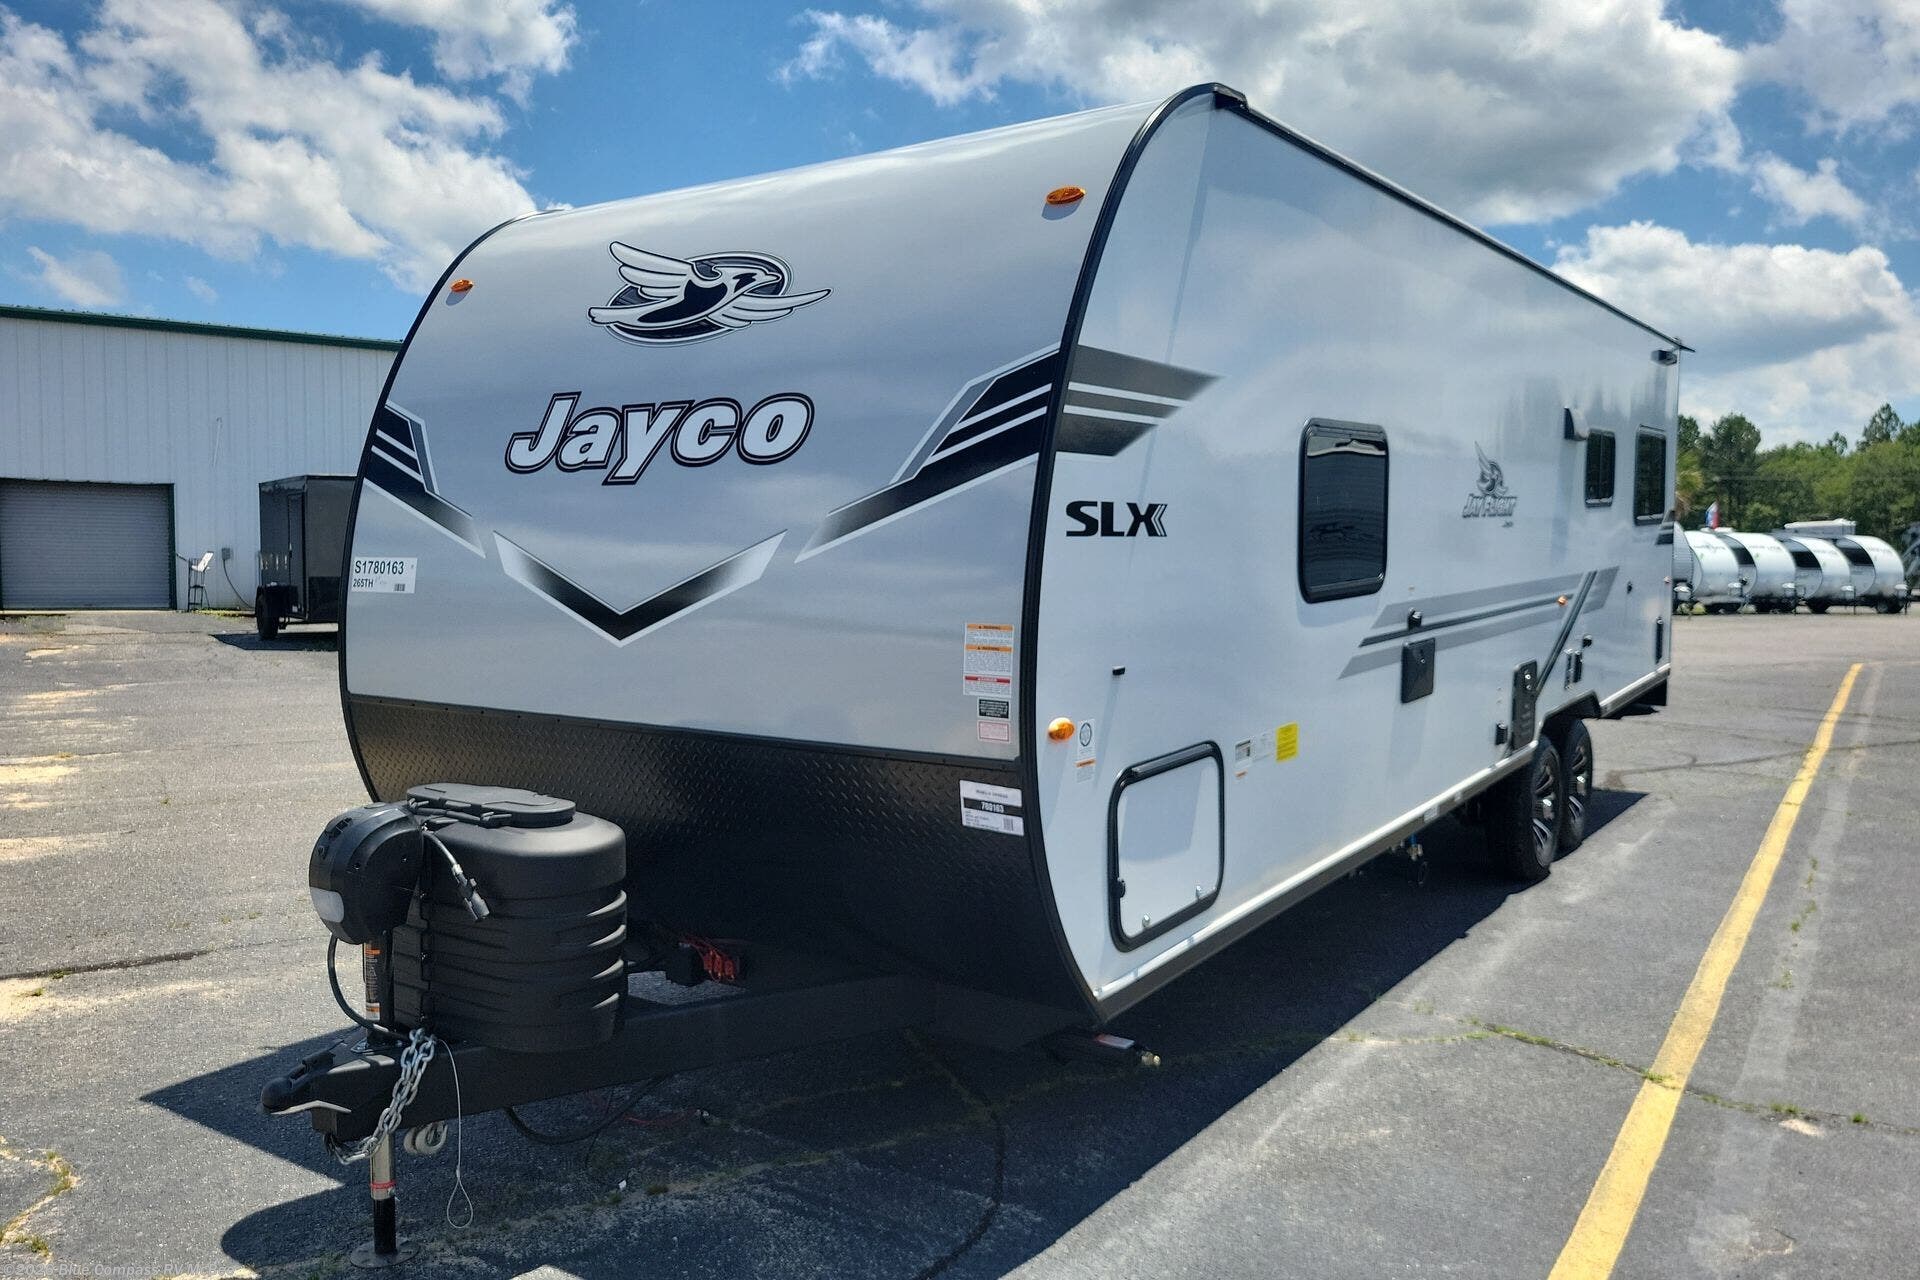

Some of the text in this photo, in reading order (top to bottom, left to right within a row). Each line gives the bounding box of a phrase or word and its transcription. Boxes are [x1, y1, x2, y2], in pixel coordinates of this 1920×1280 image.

[505, 391, 815, 486] Jayco
[1065, 500, 1168, 537] SLX
[355, 560, 404, 575] S1780163
[353, 578, 373, 588] 265TH
